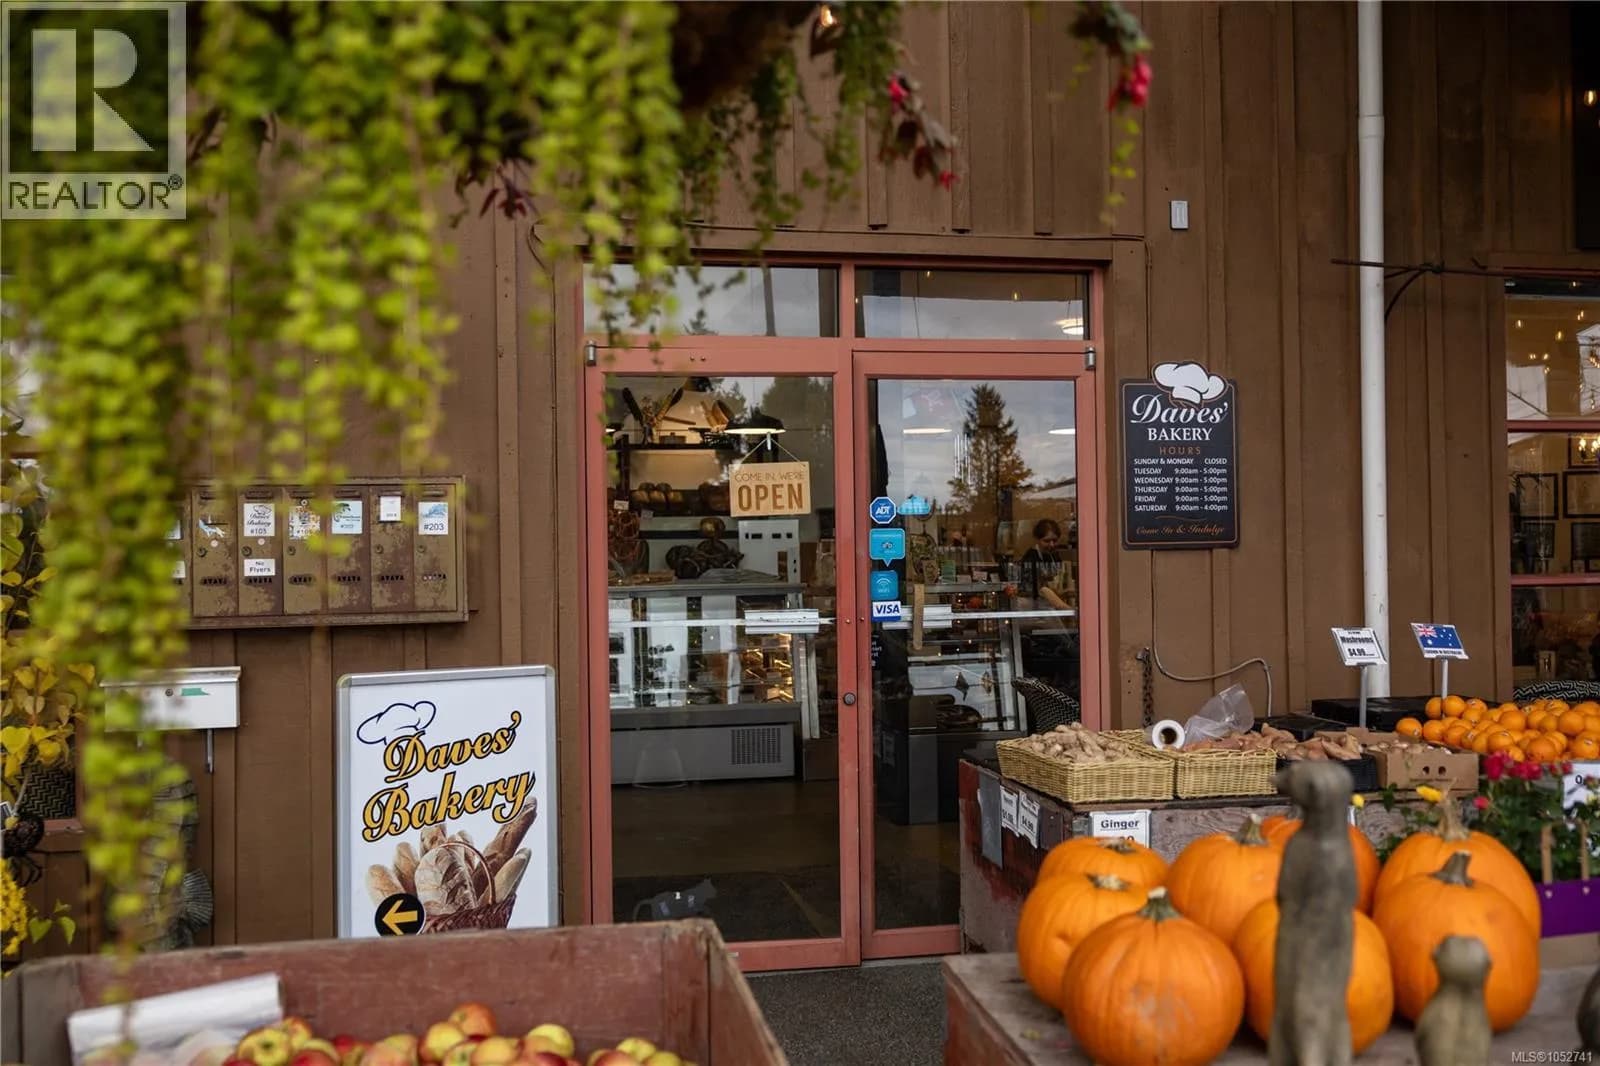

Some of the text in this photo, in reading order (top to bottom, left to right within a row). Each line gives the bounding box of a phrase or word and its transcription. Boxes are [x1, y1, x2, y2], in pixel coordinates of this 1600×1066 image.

[1147, 428, 1212, 440] BAKERY
[1160, 446, 1200, 455] HOURS
[735, 473, 761, 482] COME
[1204, 477, 1227, 485] 5:00pm
[1204, 486, 1227, 494] 5:00pm
[738, 483, 803, 511] OPEN
[1204, 495, 1227, 503] 5:00pm
[875, 506, 890, 514] ADT
[1204, 504, 1228, 512] 4:00pm
[423, 523, 444, 531] #203
[1137, 523, 1225, 535] Come In & Indulge
[876, 604, 900, 614] VISA
[384, 711, 522, 784] Daves'
[362, 771, 536, 843] Bakery
[1100, 819, 1140, 830] Ginger
